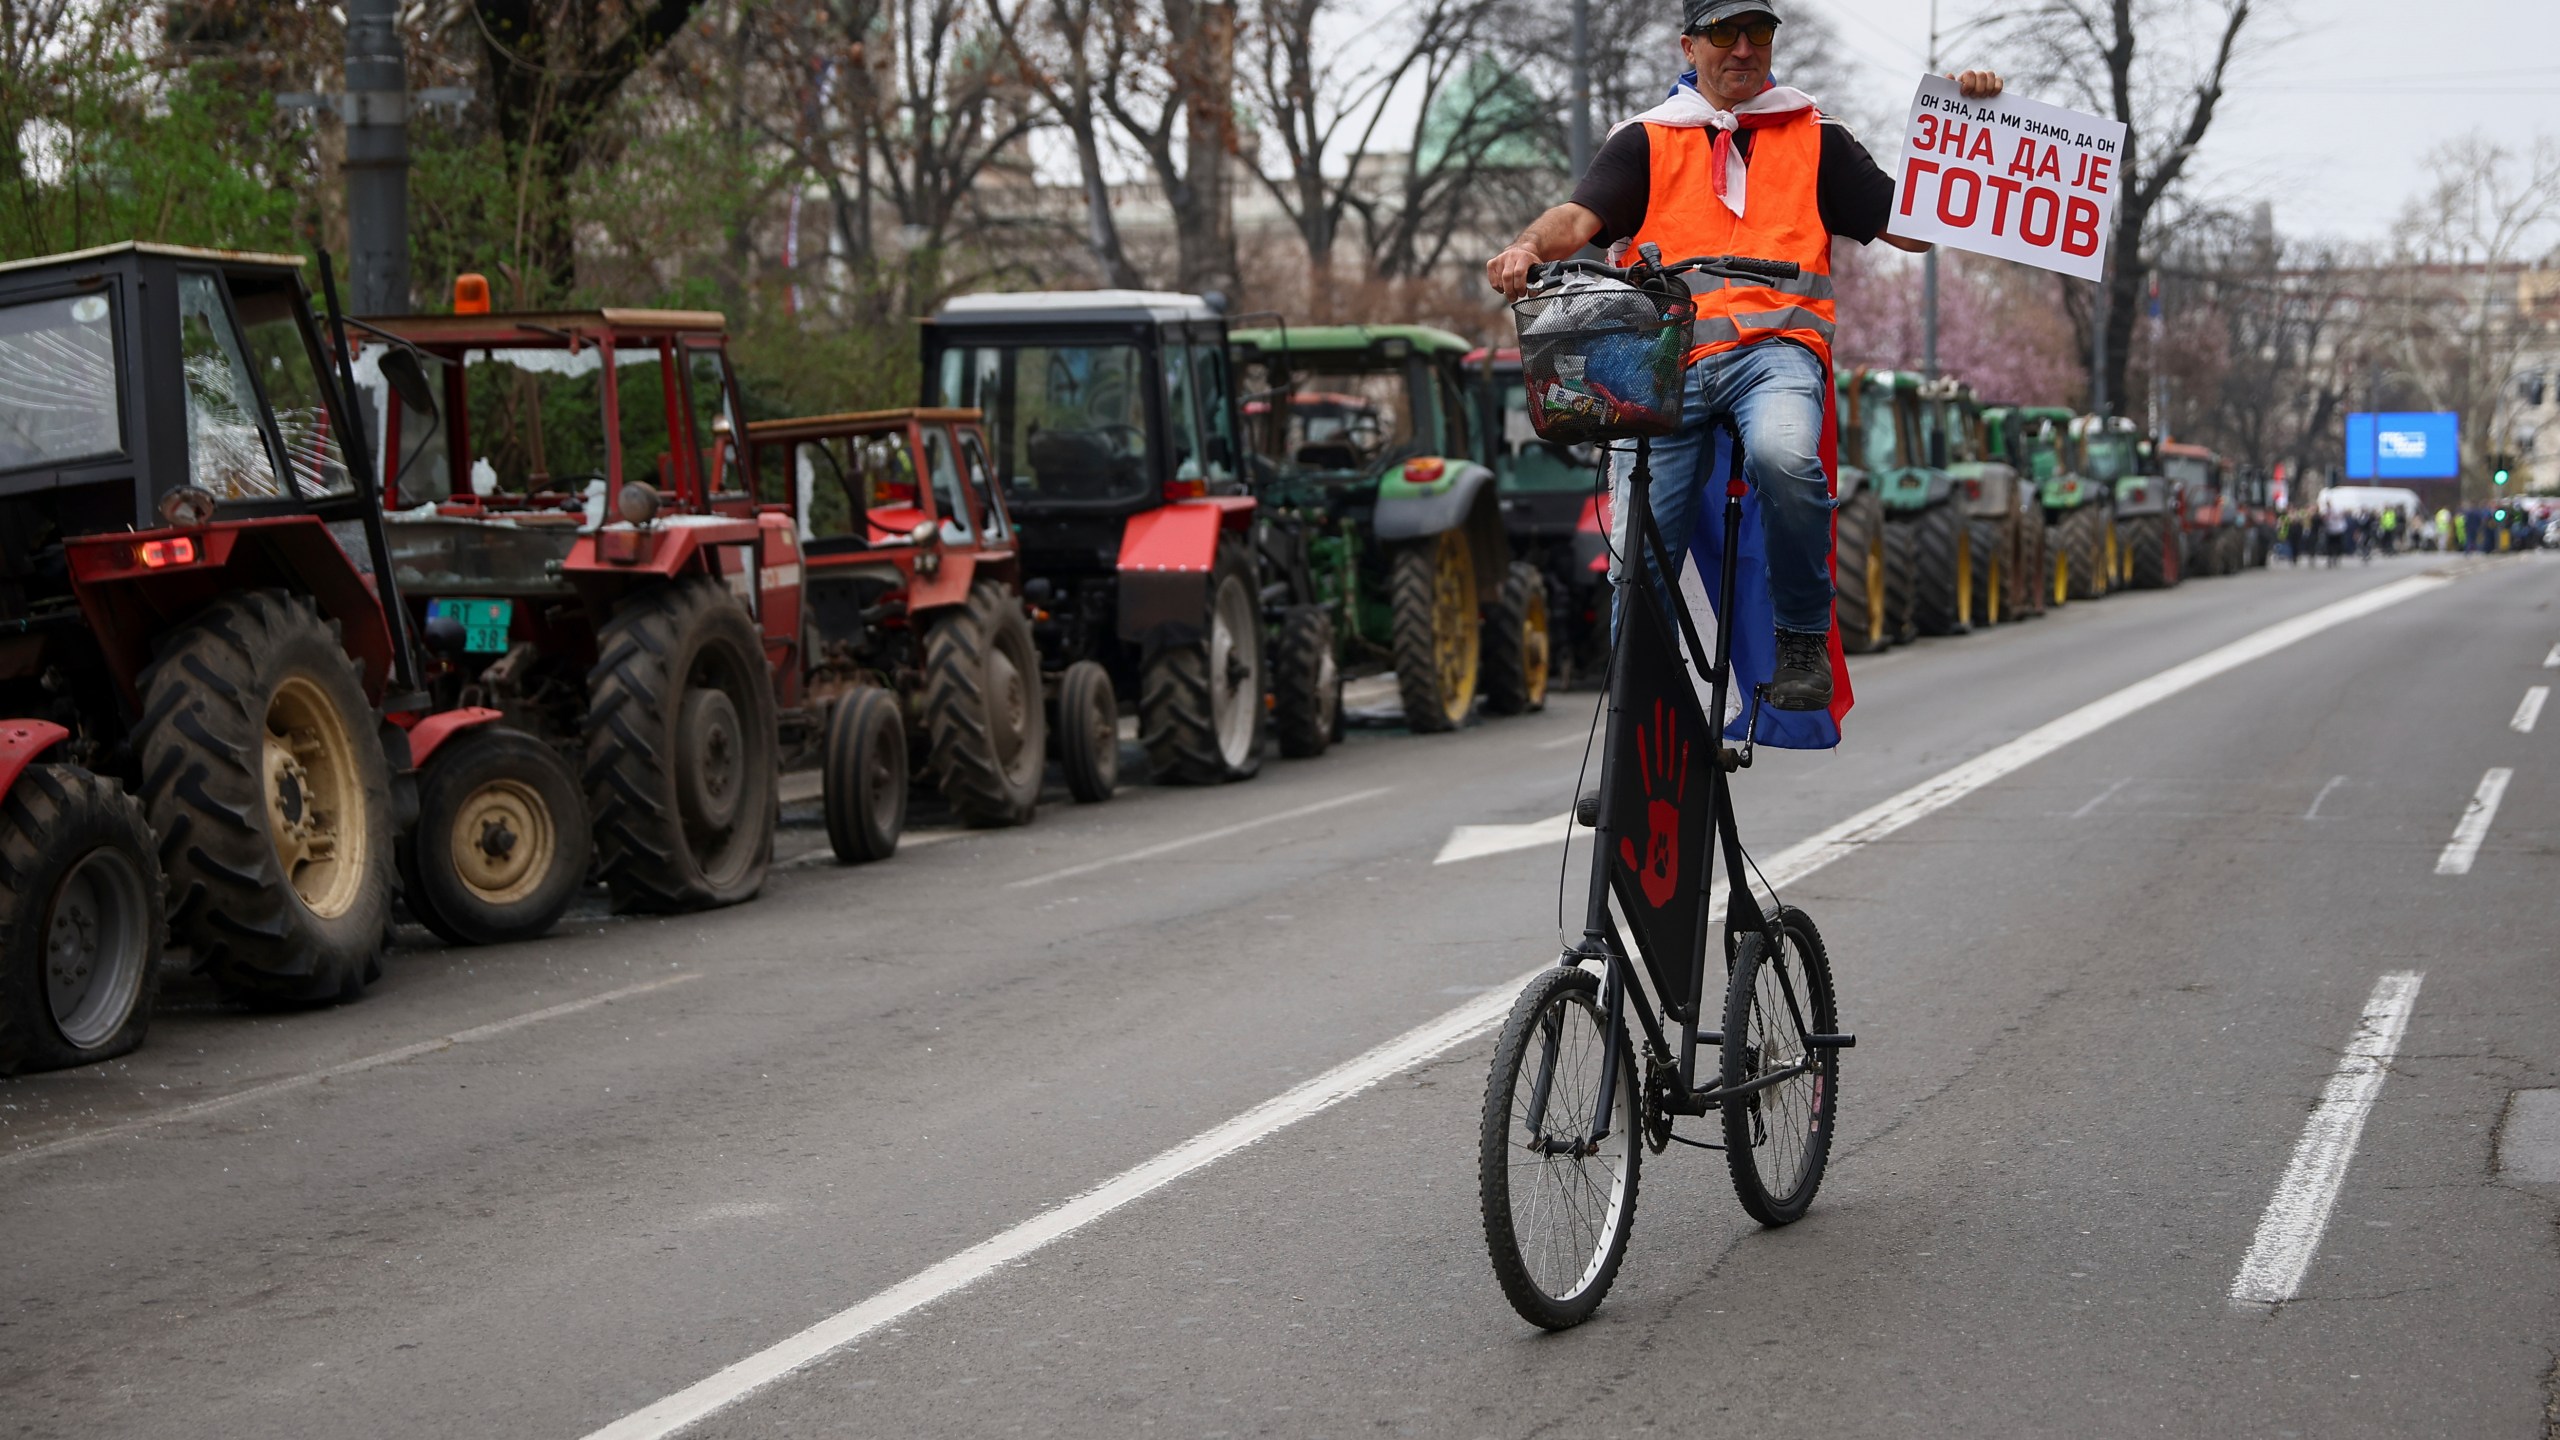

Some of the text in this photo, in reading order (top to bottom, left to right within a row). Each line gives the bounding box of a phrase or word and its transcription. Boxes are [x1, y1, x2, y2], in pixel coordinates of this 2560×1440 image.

[1912, 113, 2112, 194] ЗНА ДА ЈЕ
[1920, 93, 2115, 153] ОН ЗНА, ДА МИ ЗНАМО, ДА ОН
[1899, 156, 2100, 258] ГОТОВ
